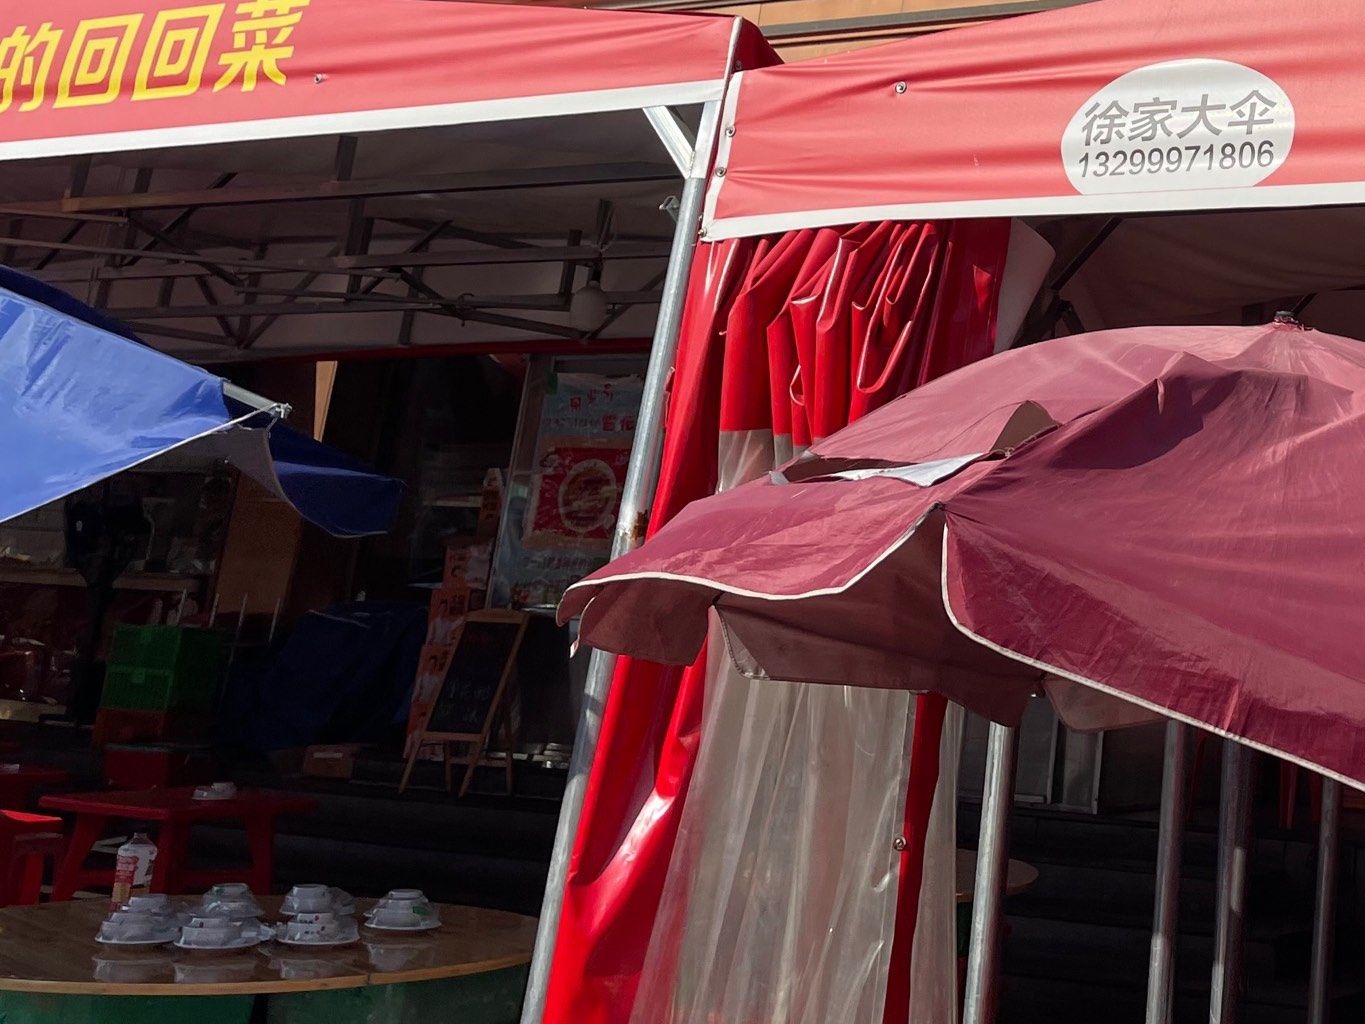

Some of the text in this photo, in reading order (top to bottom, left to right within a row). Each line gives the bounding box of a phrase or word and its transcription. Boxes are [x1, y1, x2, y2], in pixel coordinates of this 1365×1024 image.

[1081, 89, 1277, 148] 徐家大伞
[1078, 140, 1274, 178] 13299971806
